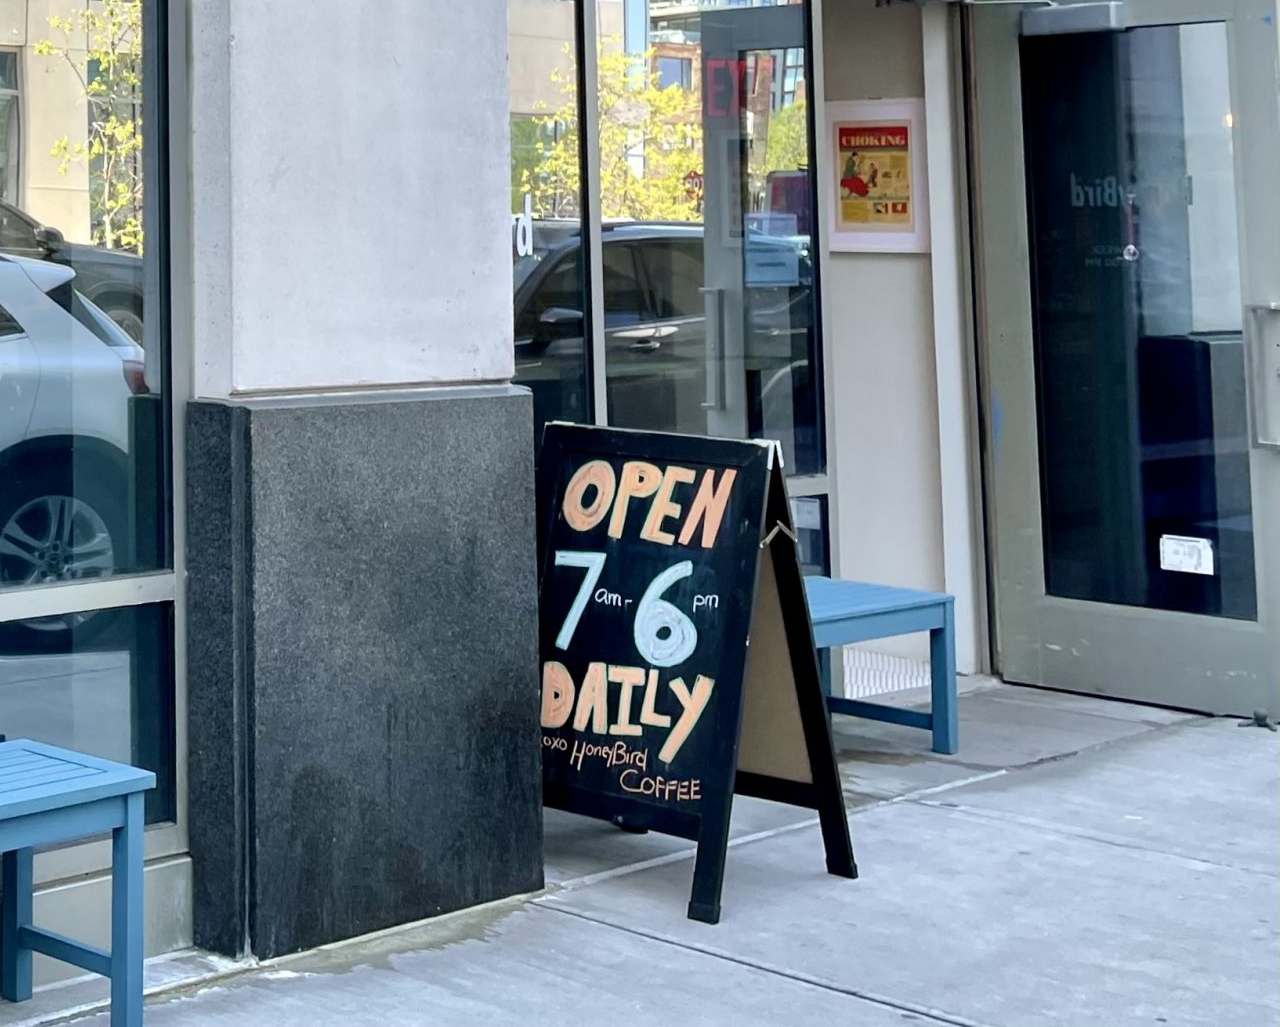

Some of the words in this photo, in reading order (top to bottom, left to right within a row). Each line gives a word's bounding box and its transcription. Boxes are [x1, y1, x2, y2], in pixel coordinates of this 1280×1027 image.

[707, 58, 774, 116] EX
[841, 135, 906, 147] CHOKING
[562, 460, 738, 548] OPEN
[554, 550, 607, 651] 7
[633, 559, 698, 668] 6
[692, 594, 719, 613] pm
[540, 660, 715, 764] DAILY
[540, 735, 568, 751] oxo
[569, 740, 648, 772] HoneyBird
[619, 768, 702, 801] COFFEE
